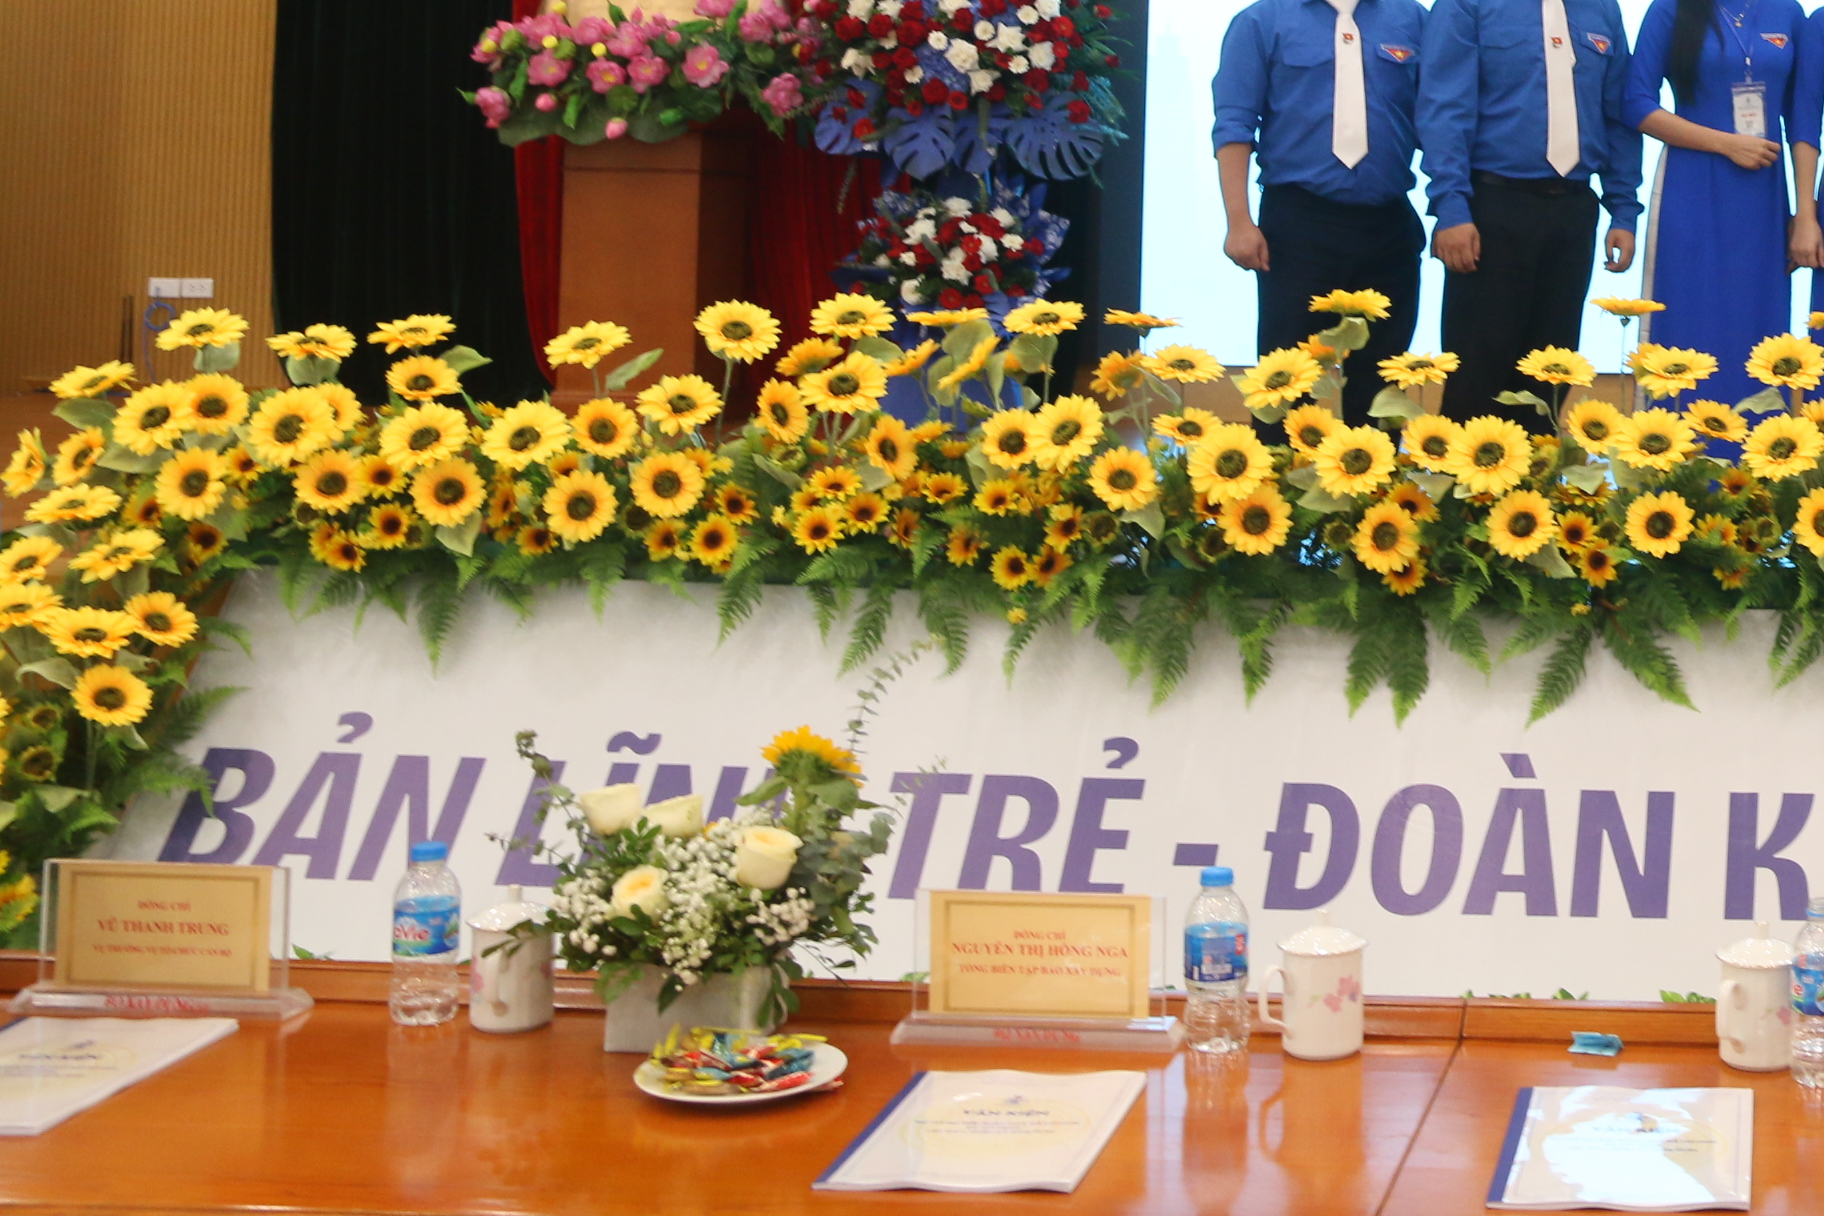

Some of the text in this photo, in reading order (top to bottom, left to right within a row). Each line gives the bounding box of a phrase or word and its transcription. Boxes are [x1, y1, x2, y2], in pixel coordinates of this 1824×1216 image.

[156, 711, 488, 881] BẢN
[888, 737, 1146, 900] TRẺ
[1173, 842, 1220, 867] -
[1263, 751, 1676, 919] ĐOÀN
[1096, 946, 1129, 958] NGA
